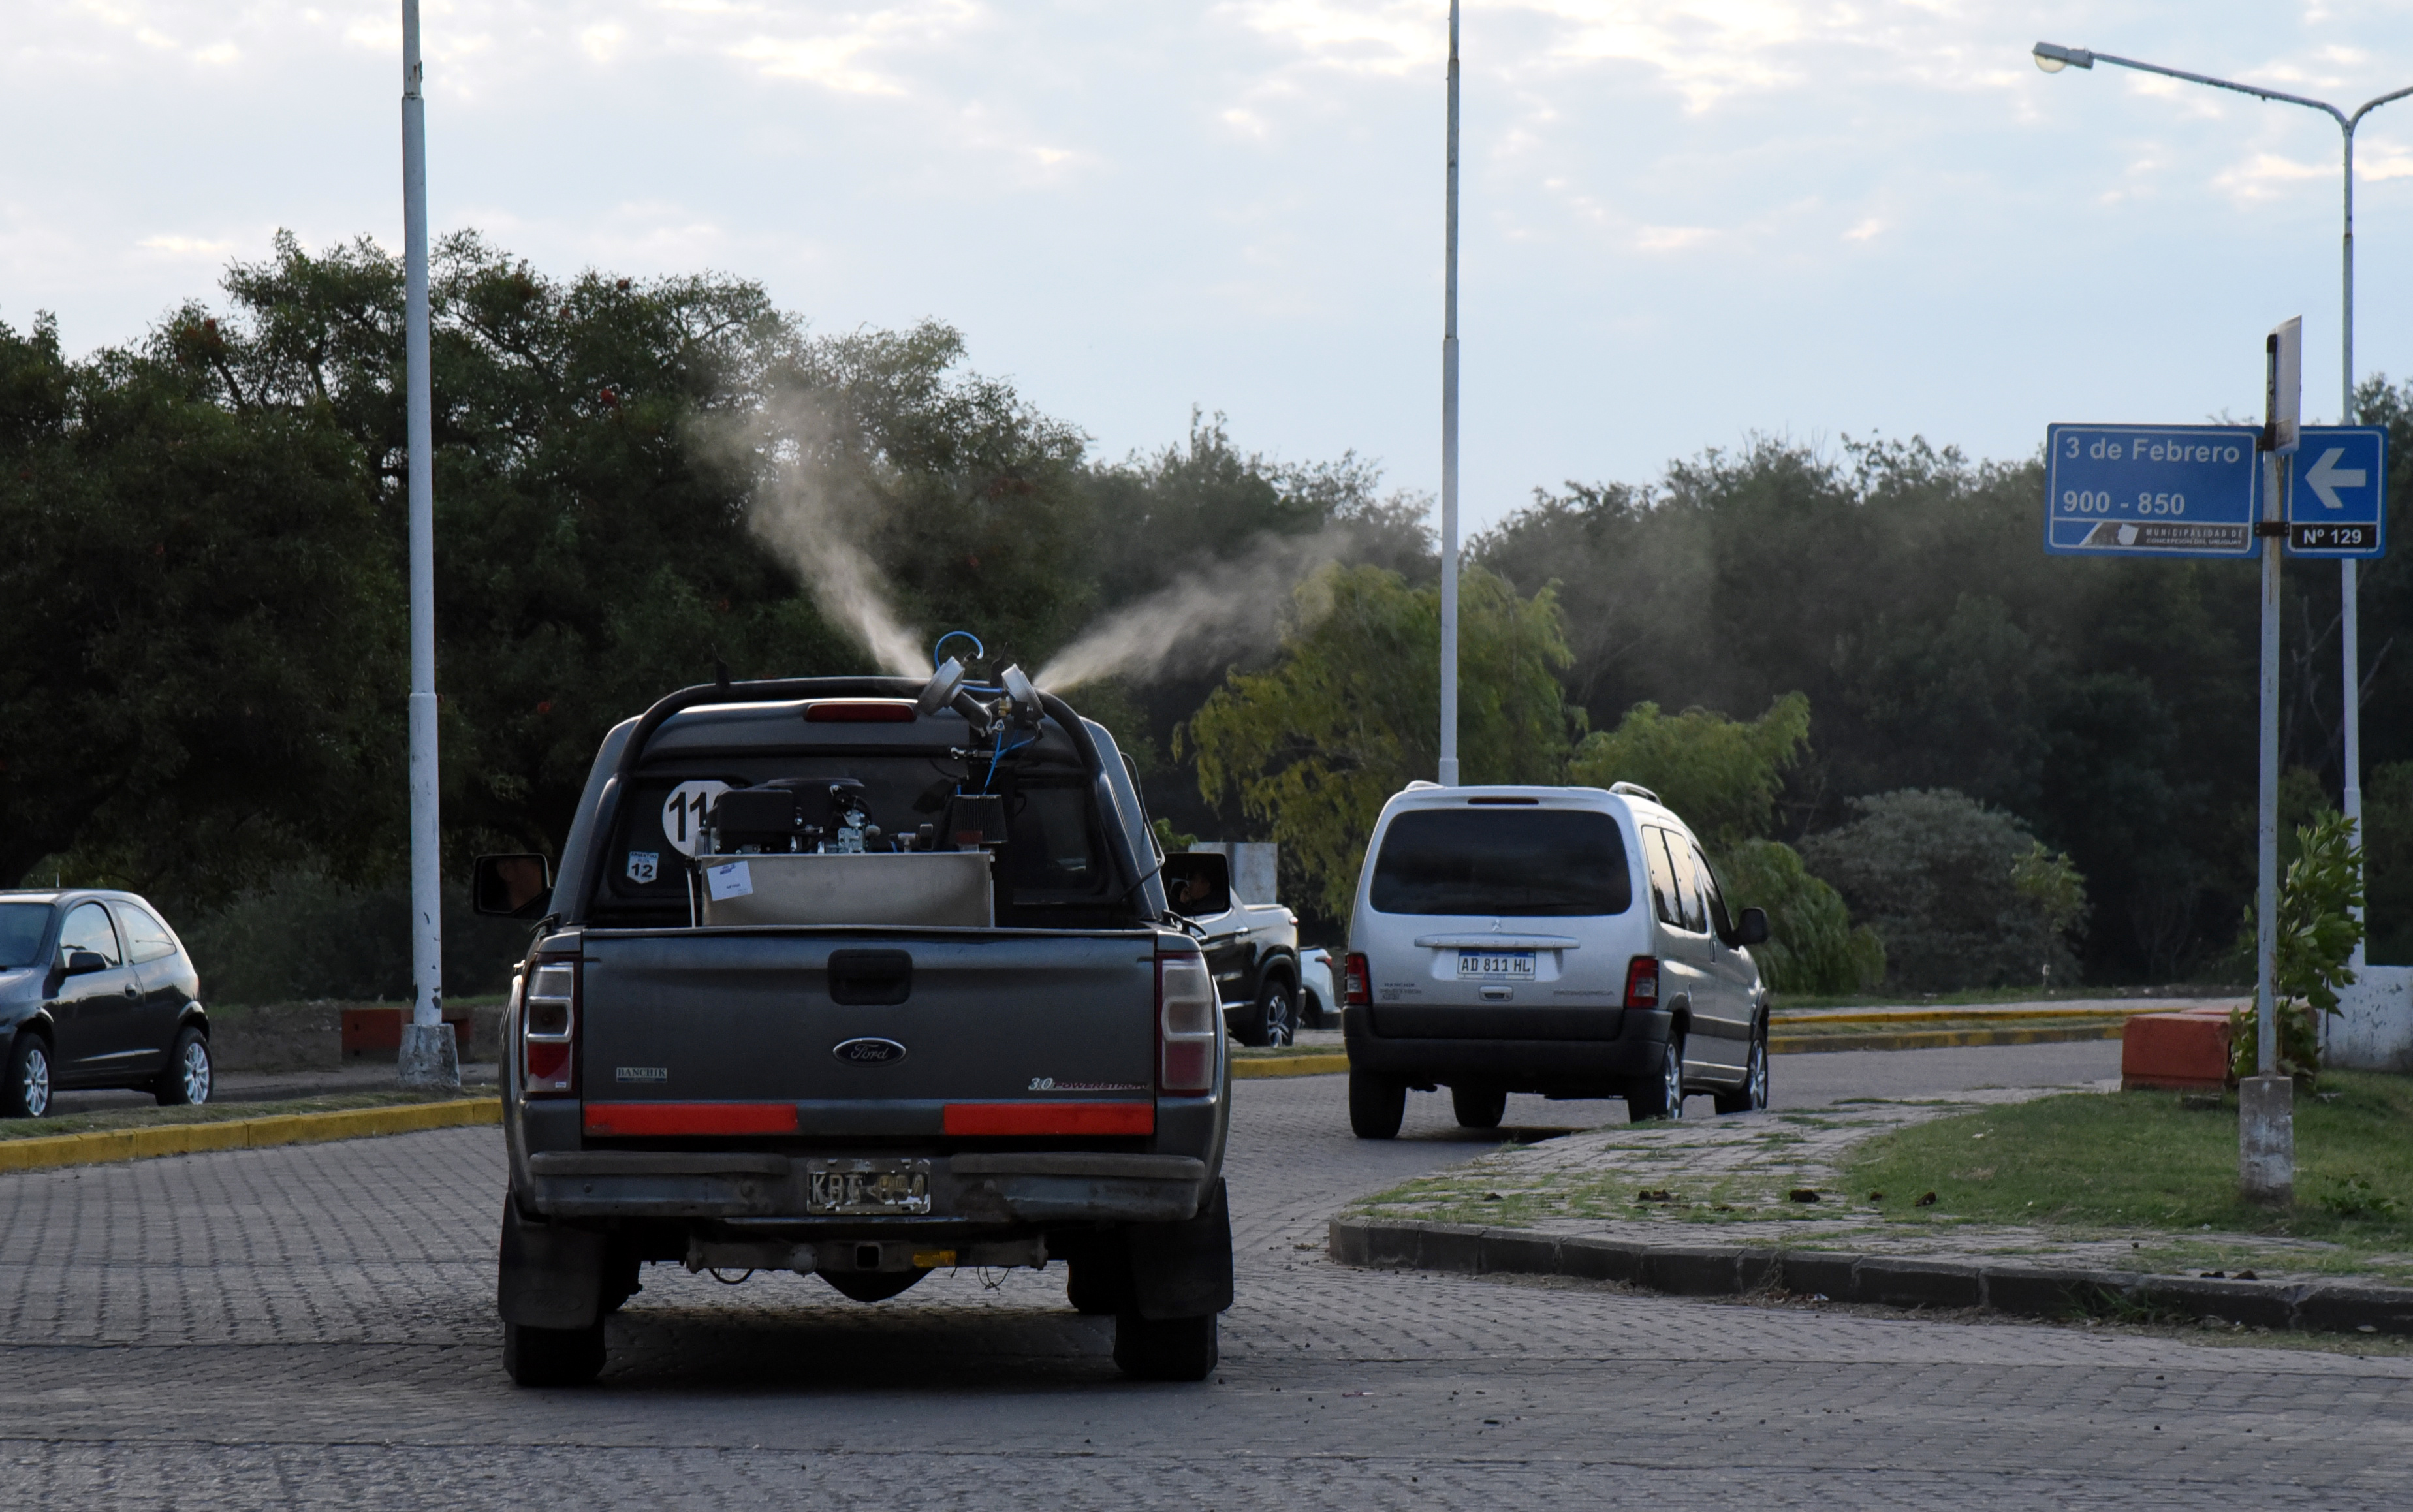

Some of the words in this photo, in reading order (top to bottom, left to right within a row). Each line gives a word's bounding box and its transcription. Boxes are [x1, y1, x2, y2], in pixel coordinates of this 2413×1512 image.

[2066, 436, 2080, 458] 3
[2090, 437, 2122, 460] de
[2132, 438, 2240, 463] Febrero
[2063, 490, 2111, 514] 900
[2137, 492, 2185, 515] 850
[2145, 528, 2226, 538] MUNICIPALIDAD
[2232, 529, 2243, 538] DE
[2330, 529, 2362, 544] 129
[669, 791, 707, 842] 11
[631, 862, 654, 878] 12
[1461, 958, 1479, 971] AD
[1483, 958, 1509, 971] 811
[1513, 959, 1531, 972] HL
[851, 1043, 889, 1059] Ford
